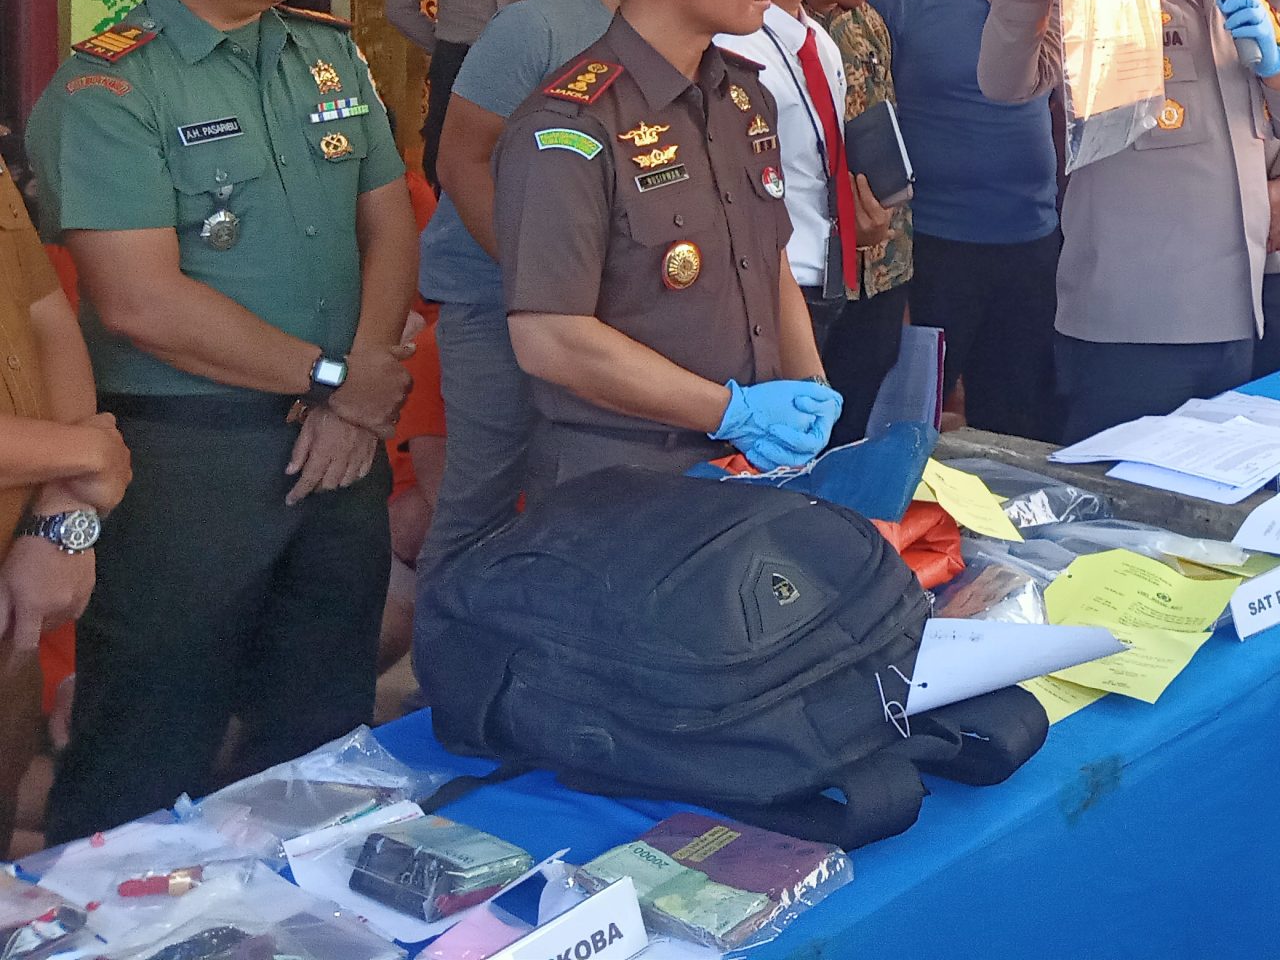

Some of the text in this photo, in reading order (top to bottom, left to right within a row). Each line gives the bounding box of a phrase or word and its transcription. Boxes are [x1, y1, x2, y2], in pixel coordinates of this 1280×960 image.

[84, 42, 115, 57] TNI
[202, 121, 239, 136] PASARIBU
[1248, 594, 1273, 616] SAT
